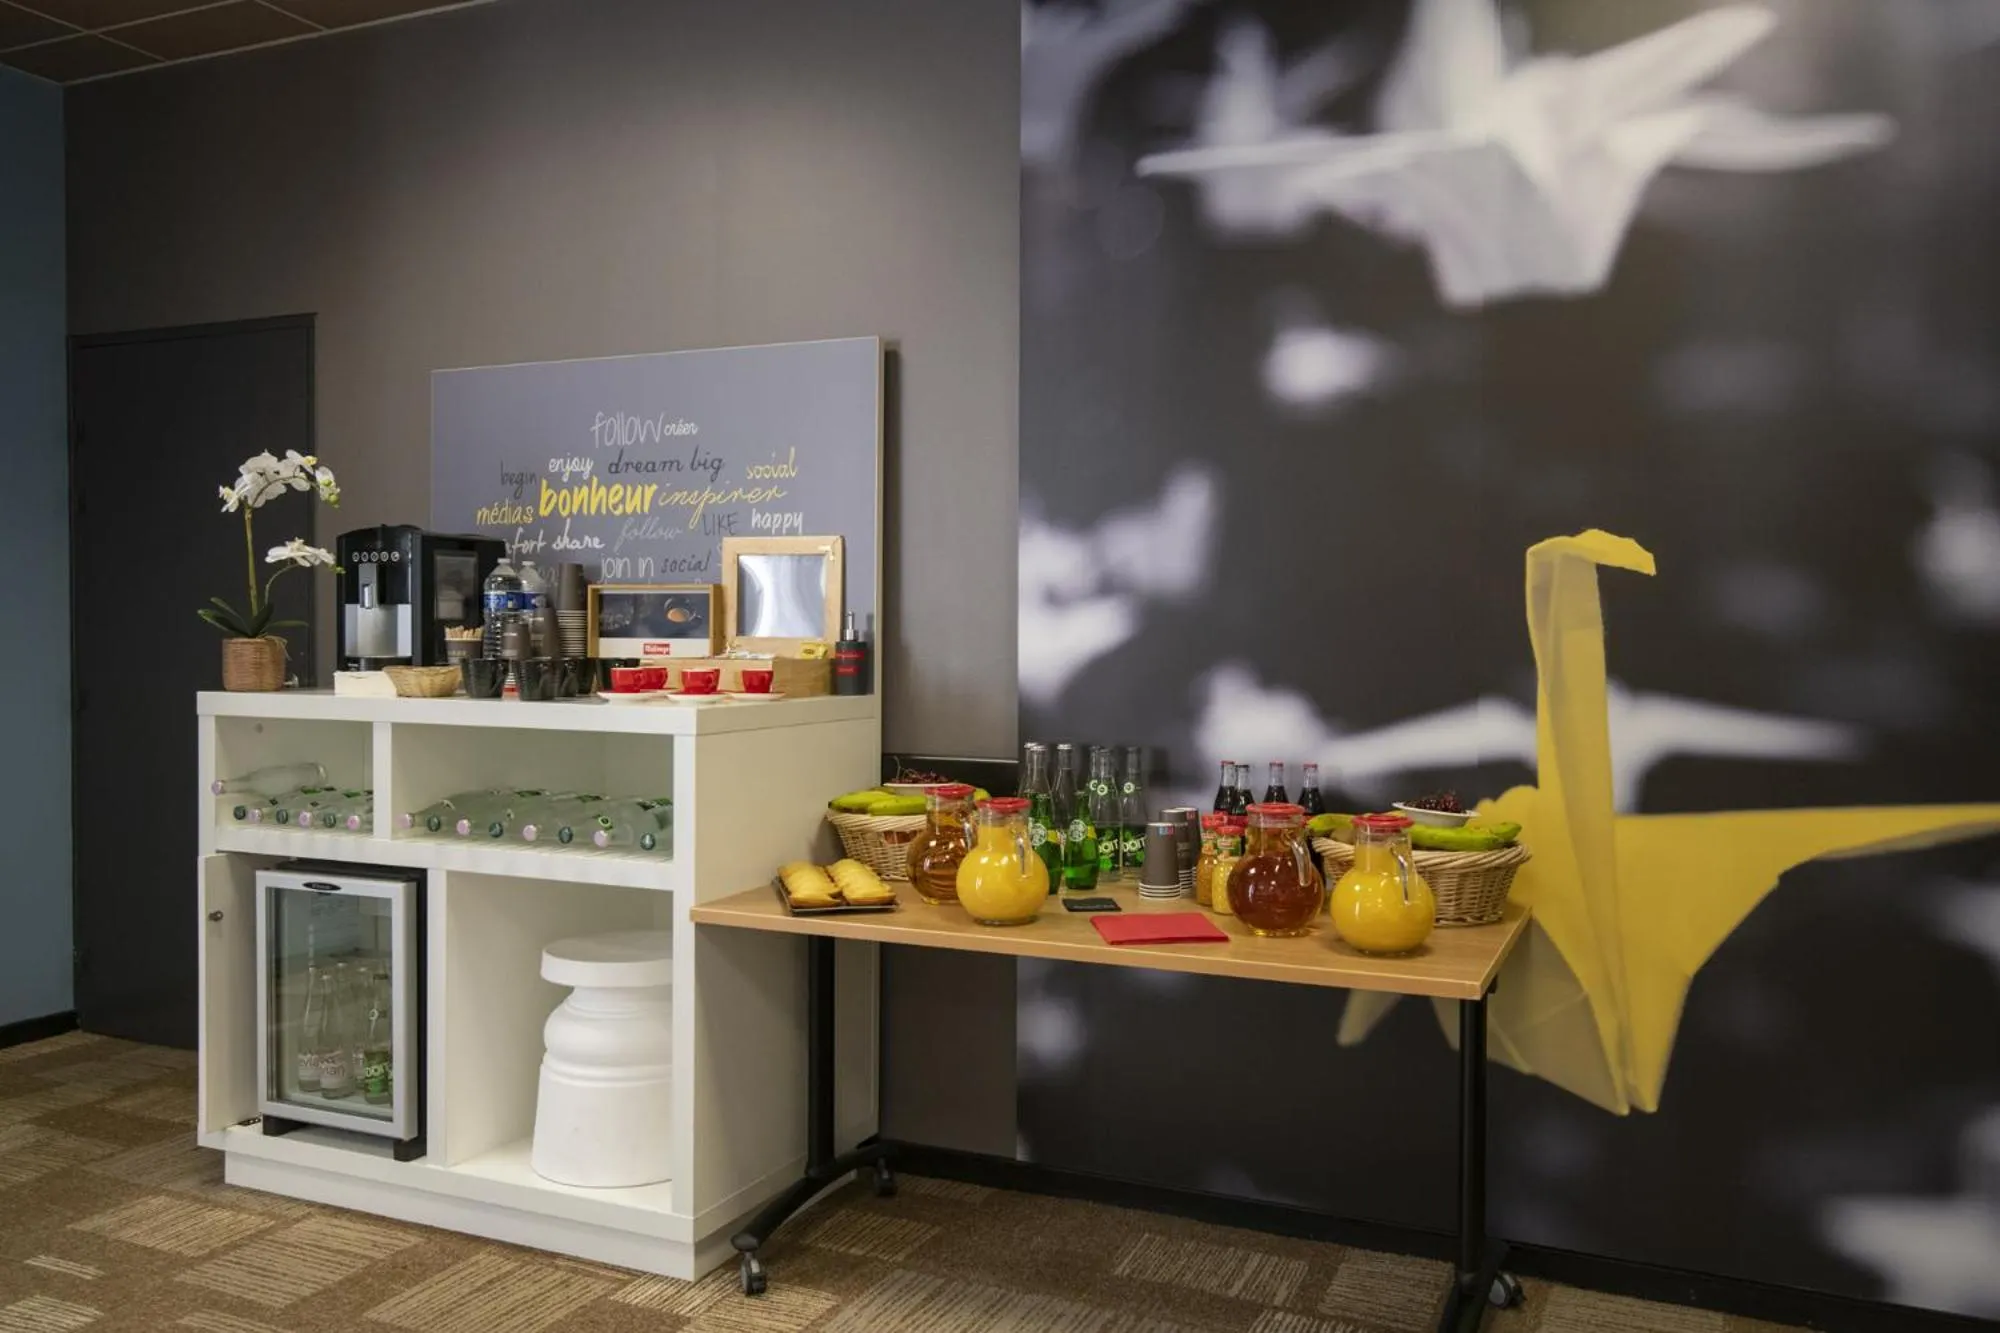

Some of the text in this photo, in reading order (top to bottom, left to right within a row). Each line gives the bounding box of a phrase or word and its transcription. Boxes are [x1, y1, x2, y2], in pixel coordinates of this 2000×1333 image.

[589, 411, 665, 448] follow
[500, 460, 537, 498] begin
[549, 452, 594, 482] enjoy
[608, 444, 725, 482] dream big
[746, 446, 798, 479] social
[476, 499, 534, 525] médias
[539, 476, 659, 517] bonheur
[658, 480, 787, 529] inspirer
[552, 518, 605, 550] share
[614, 516, 683, 554] follow
[702, 512, 739, 536] LIKE
[751, 507, 803, 534] happy
[661, 550, 711, 574] social
